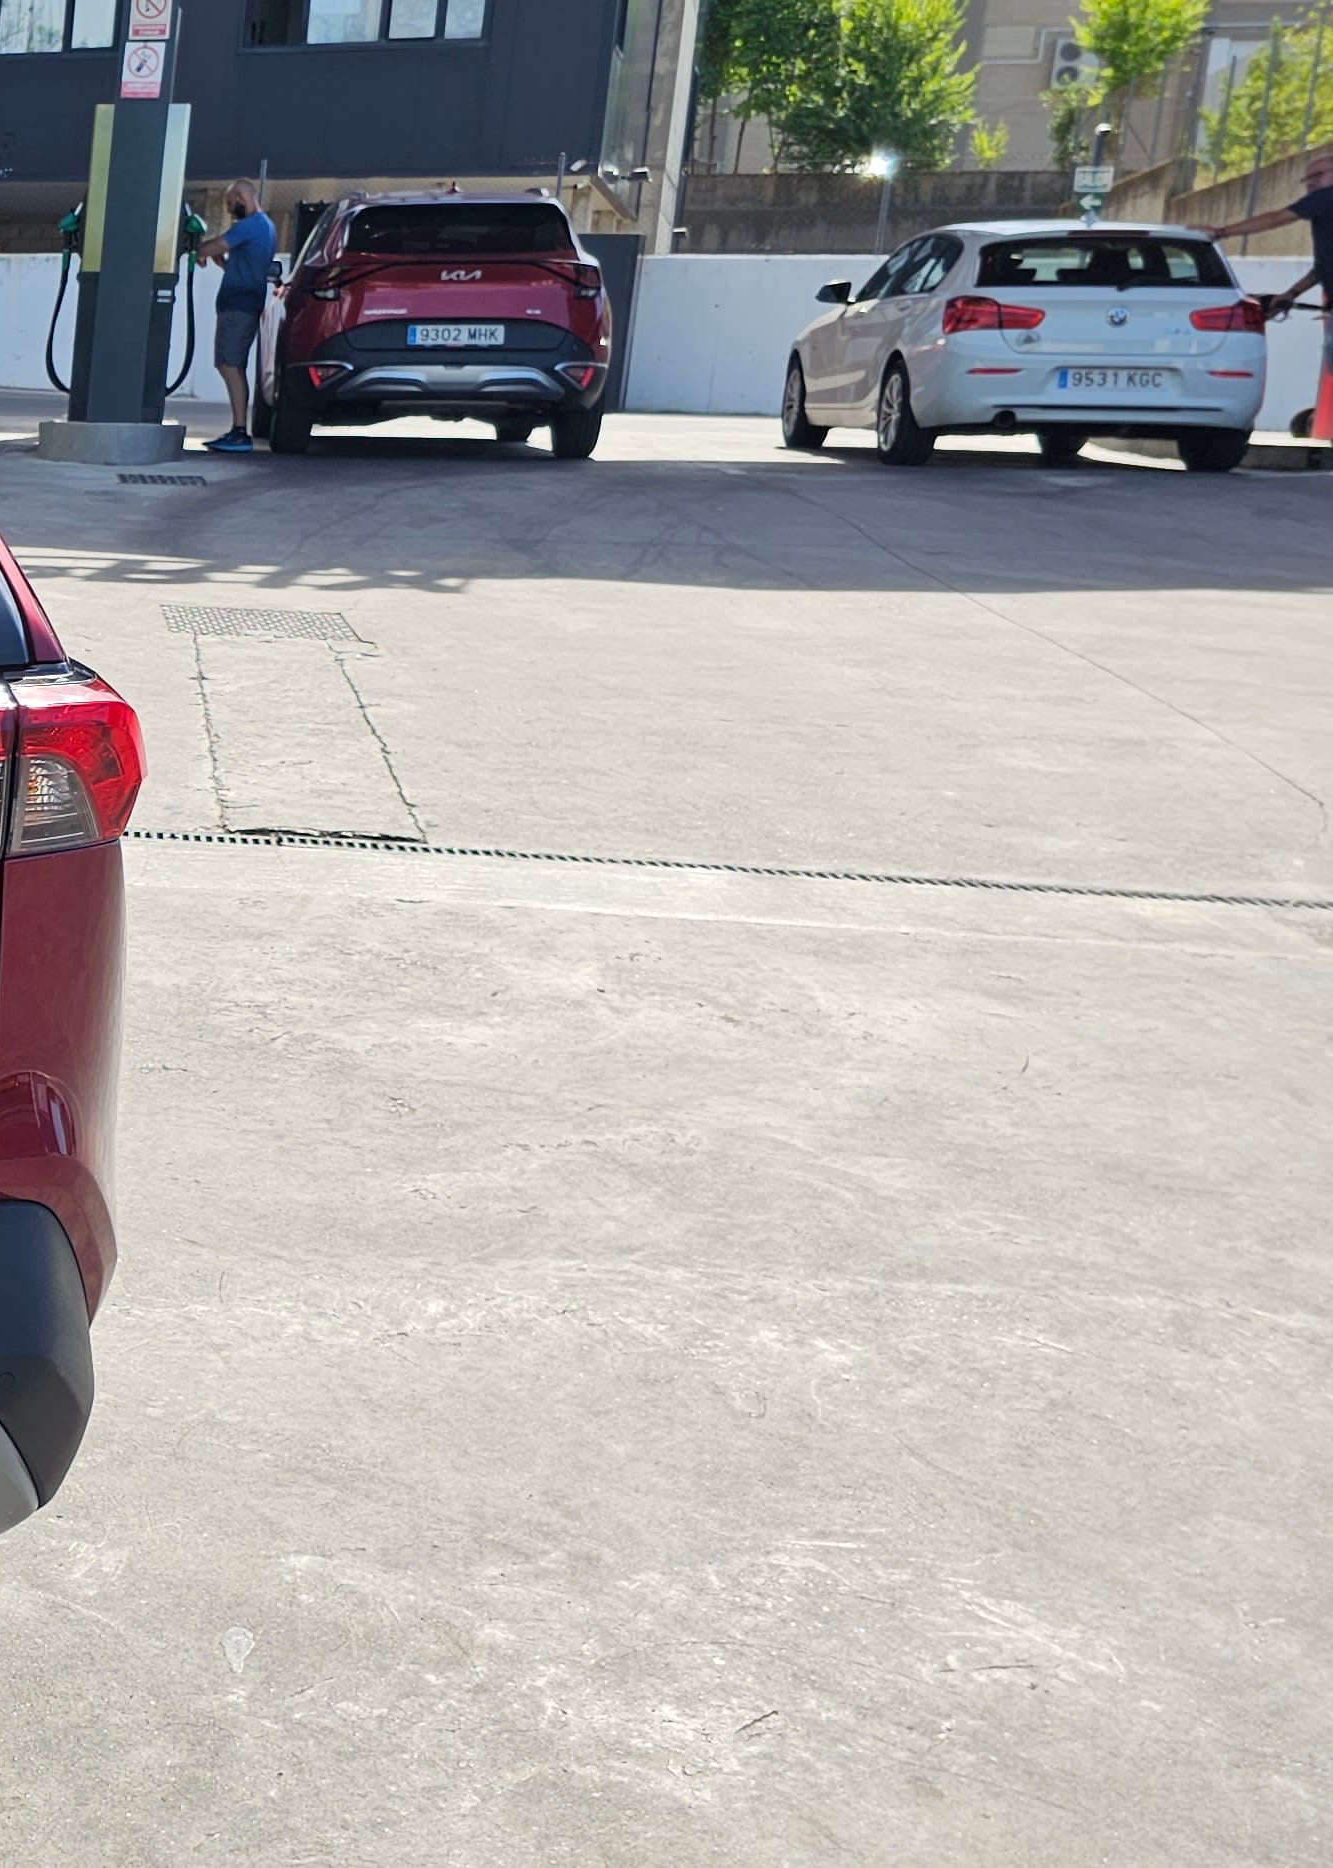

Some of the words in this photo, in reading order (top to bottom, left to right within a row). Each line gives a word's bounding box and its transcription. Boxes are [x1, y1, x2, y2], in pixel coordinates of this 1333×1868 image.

[420, 328, 462, 342] 9302
[467, 328, 500, 342] MHK
[1072, 372, 1118, 388] 9531
[1126, 372, 1163, 388] KGC
